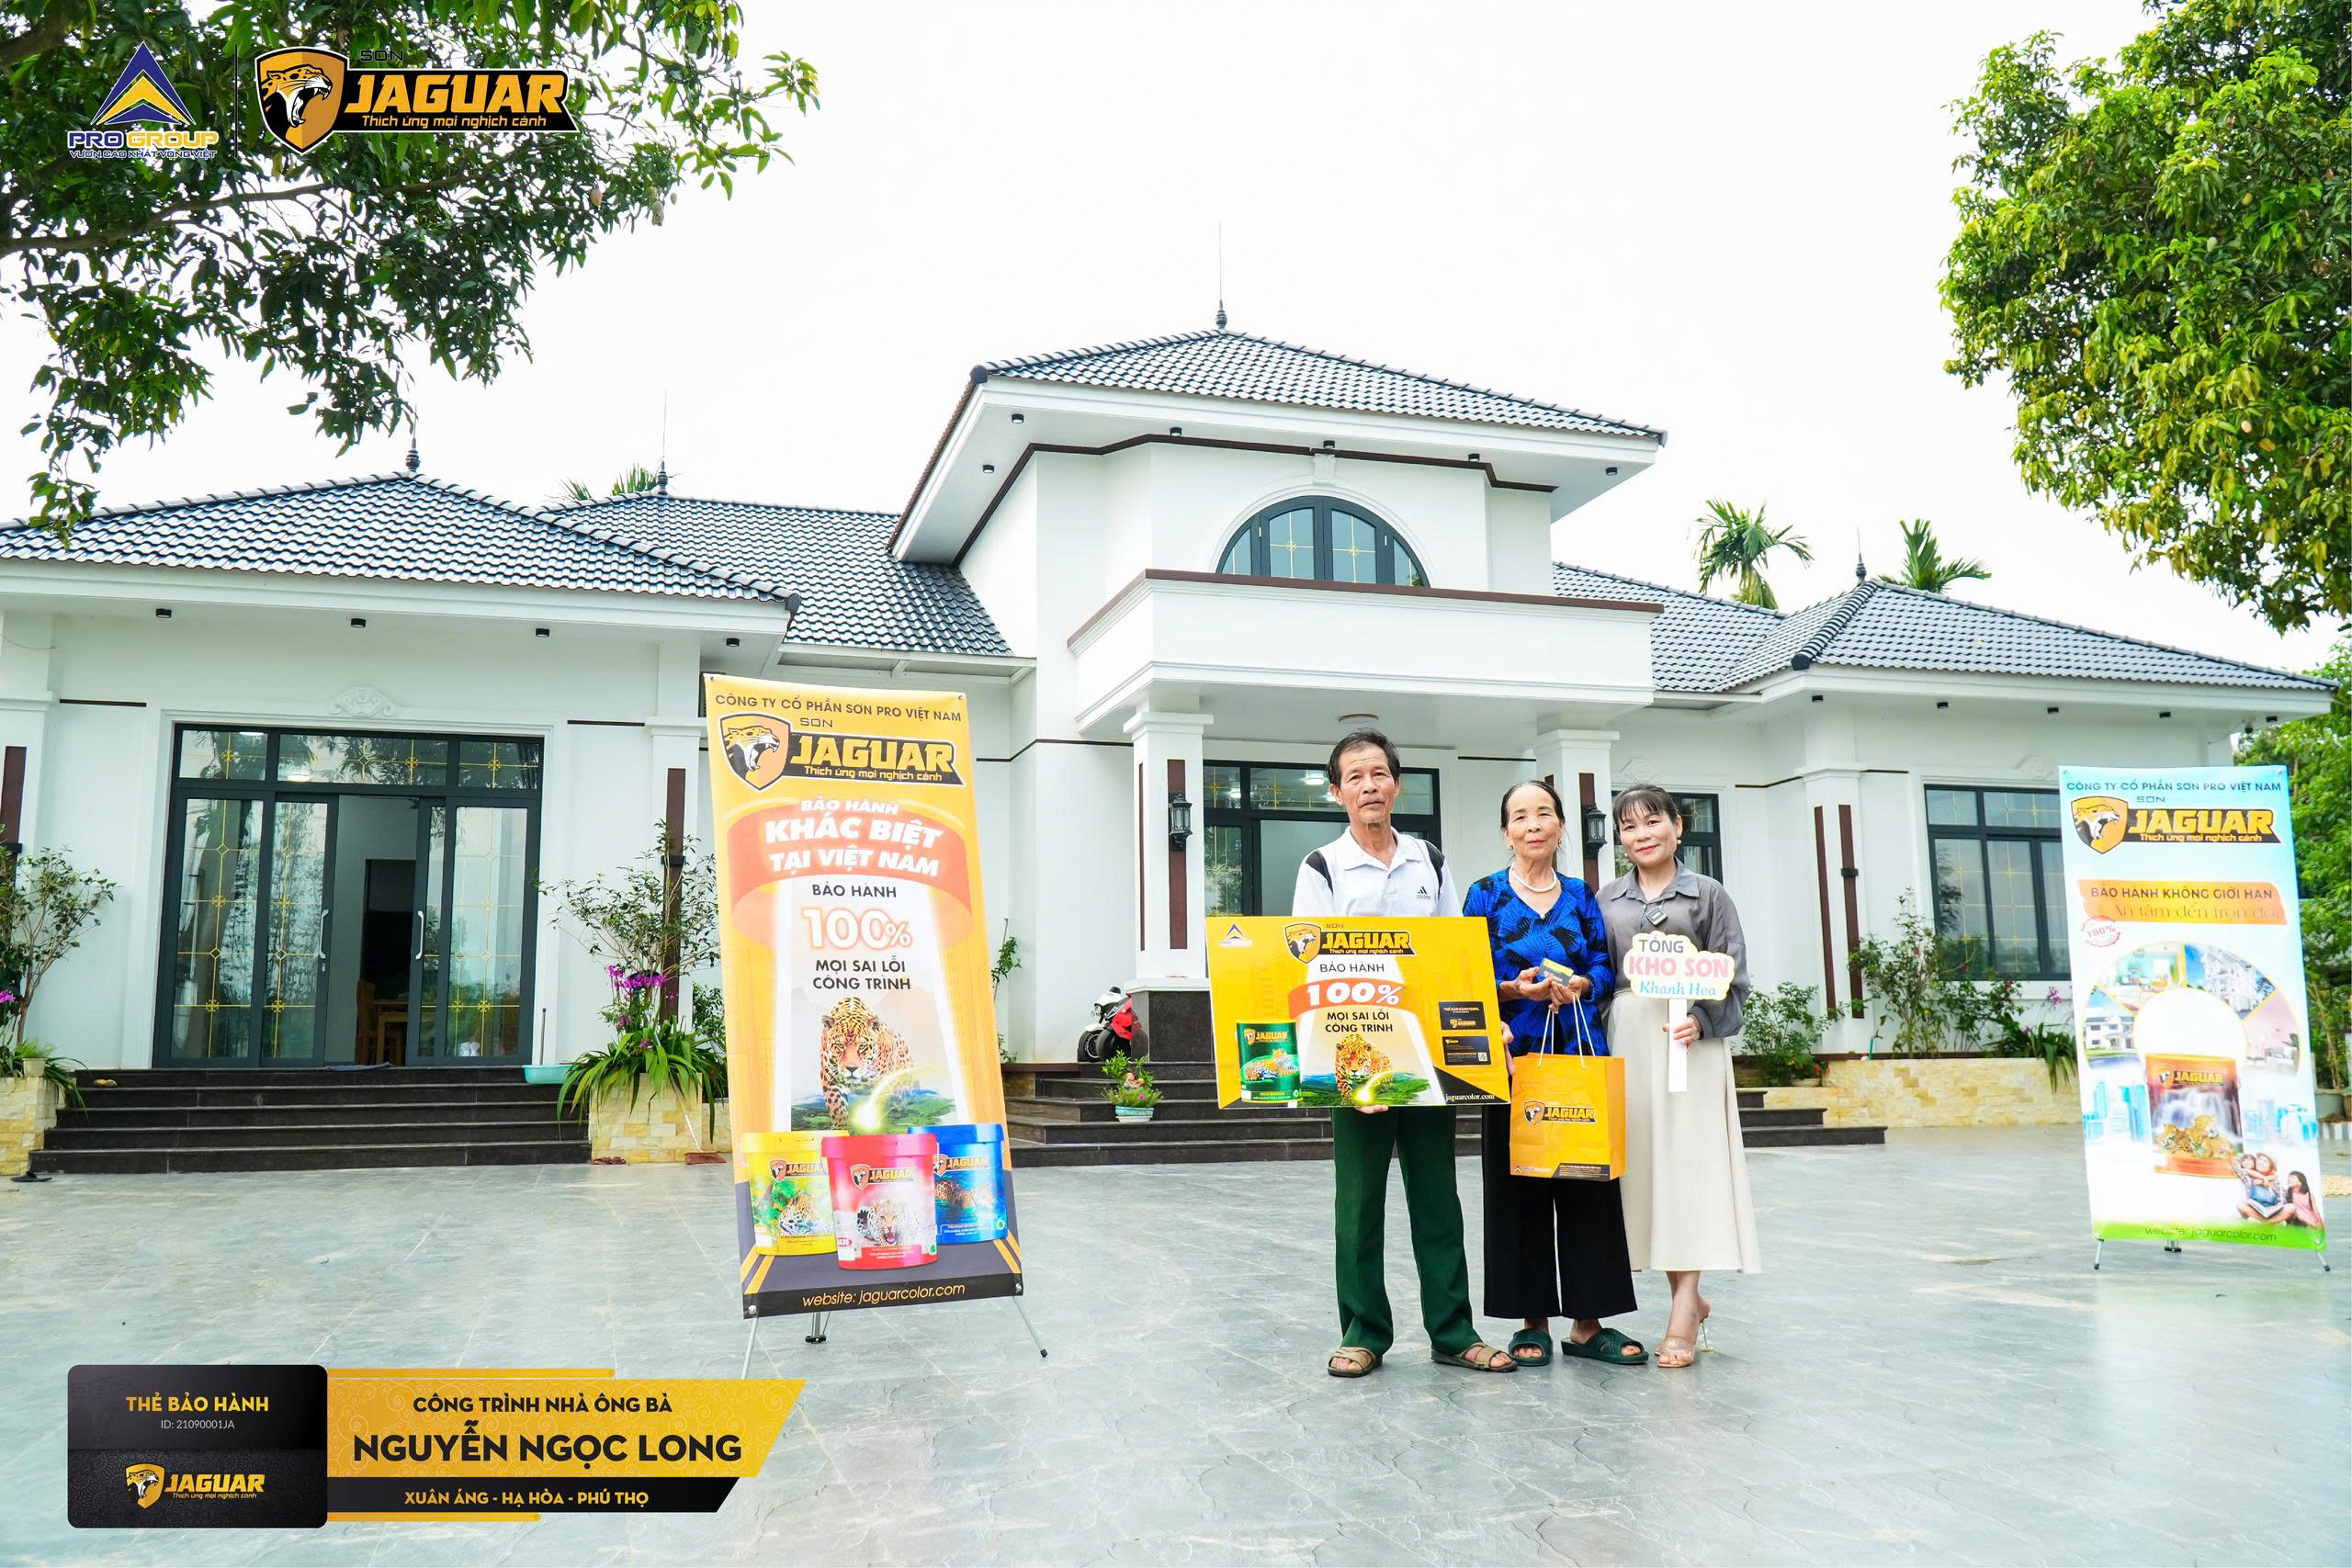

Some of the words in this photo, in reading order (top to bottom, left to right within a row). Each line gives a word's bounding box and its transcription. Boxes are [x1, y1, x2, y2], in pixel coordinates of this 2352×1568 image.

[716, 694, 758, 707] CÔNG
[762, 698, 776, 708] TY
[781, 695, 802, 710] CỔ
[806, 698, 842, 713] PHẦN
[846, 703, 872, 715] SƠN
[876, 706, 901, 717] PRO
[906, 707, 929, 722] VIỆT
[933, 711, 962, 722] NAM
[790, 735, 955, 773] JAGUAR
[2105, 782, 2117, 790] TY
[2204, 783, 2226, 791] PRO
[2256, 783, 2281, 791] NAM
[801, 795, 840, 812] BẢO
[845, 798, 899, 816] HÀNH
[2128, 809, 2274, 834] JAGUAR
[765, 812, 862, 844] KHÁC
[869, 819, 944, 851] BIỆT
[770, 850, 811, 875] TẠI
[818, 844, 875, 872] VIỆT
[878, 851, 939, 877] NAM
[812, 881, 845, 897] BẢO
[851, 882, 897, 898] HÀNH
[801, 906, 912, 951] 100%
[1322, 932, 1409, 949] JAGUAR
[816, 960, 846, 976] MỌI
[853, 960, 876, 972] SAI
[882, 955, 906, 973] LỖI
[1629, 955, 1677, 976] KHO
[813, 974, 860, 989] CÔNG
[865, 974, 911, 990] TRÌNH
[1306, 981, 1404, 1006] 100%
[1327, 1011, 1349, 1022] MỌI
[1352, 1011, 1369, 1020] SAI
[1325, 1021, 1358, 1032] CÔNG
[1255, 1032, 1288, 1041] JAGUAR
[2174, 1071, 2224, 1083] JAGUAR
[1445, 1093, 1496, 1102] jaguarcolor.com
[1544, 1108, 1595, 1119] JAGUAR
[947, 1157, 988, 1168] JAGUAR
[869, 1169, 912, 1180] JAGUAR
[2191, 1227, 2277, 1241] jaguarcolor.com
[803, 1292, 857, 1307] website:
[858, 1284, 966, 1305] jaguarcolor.com
